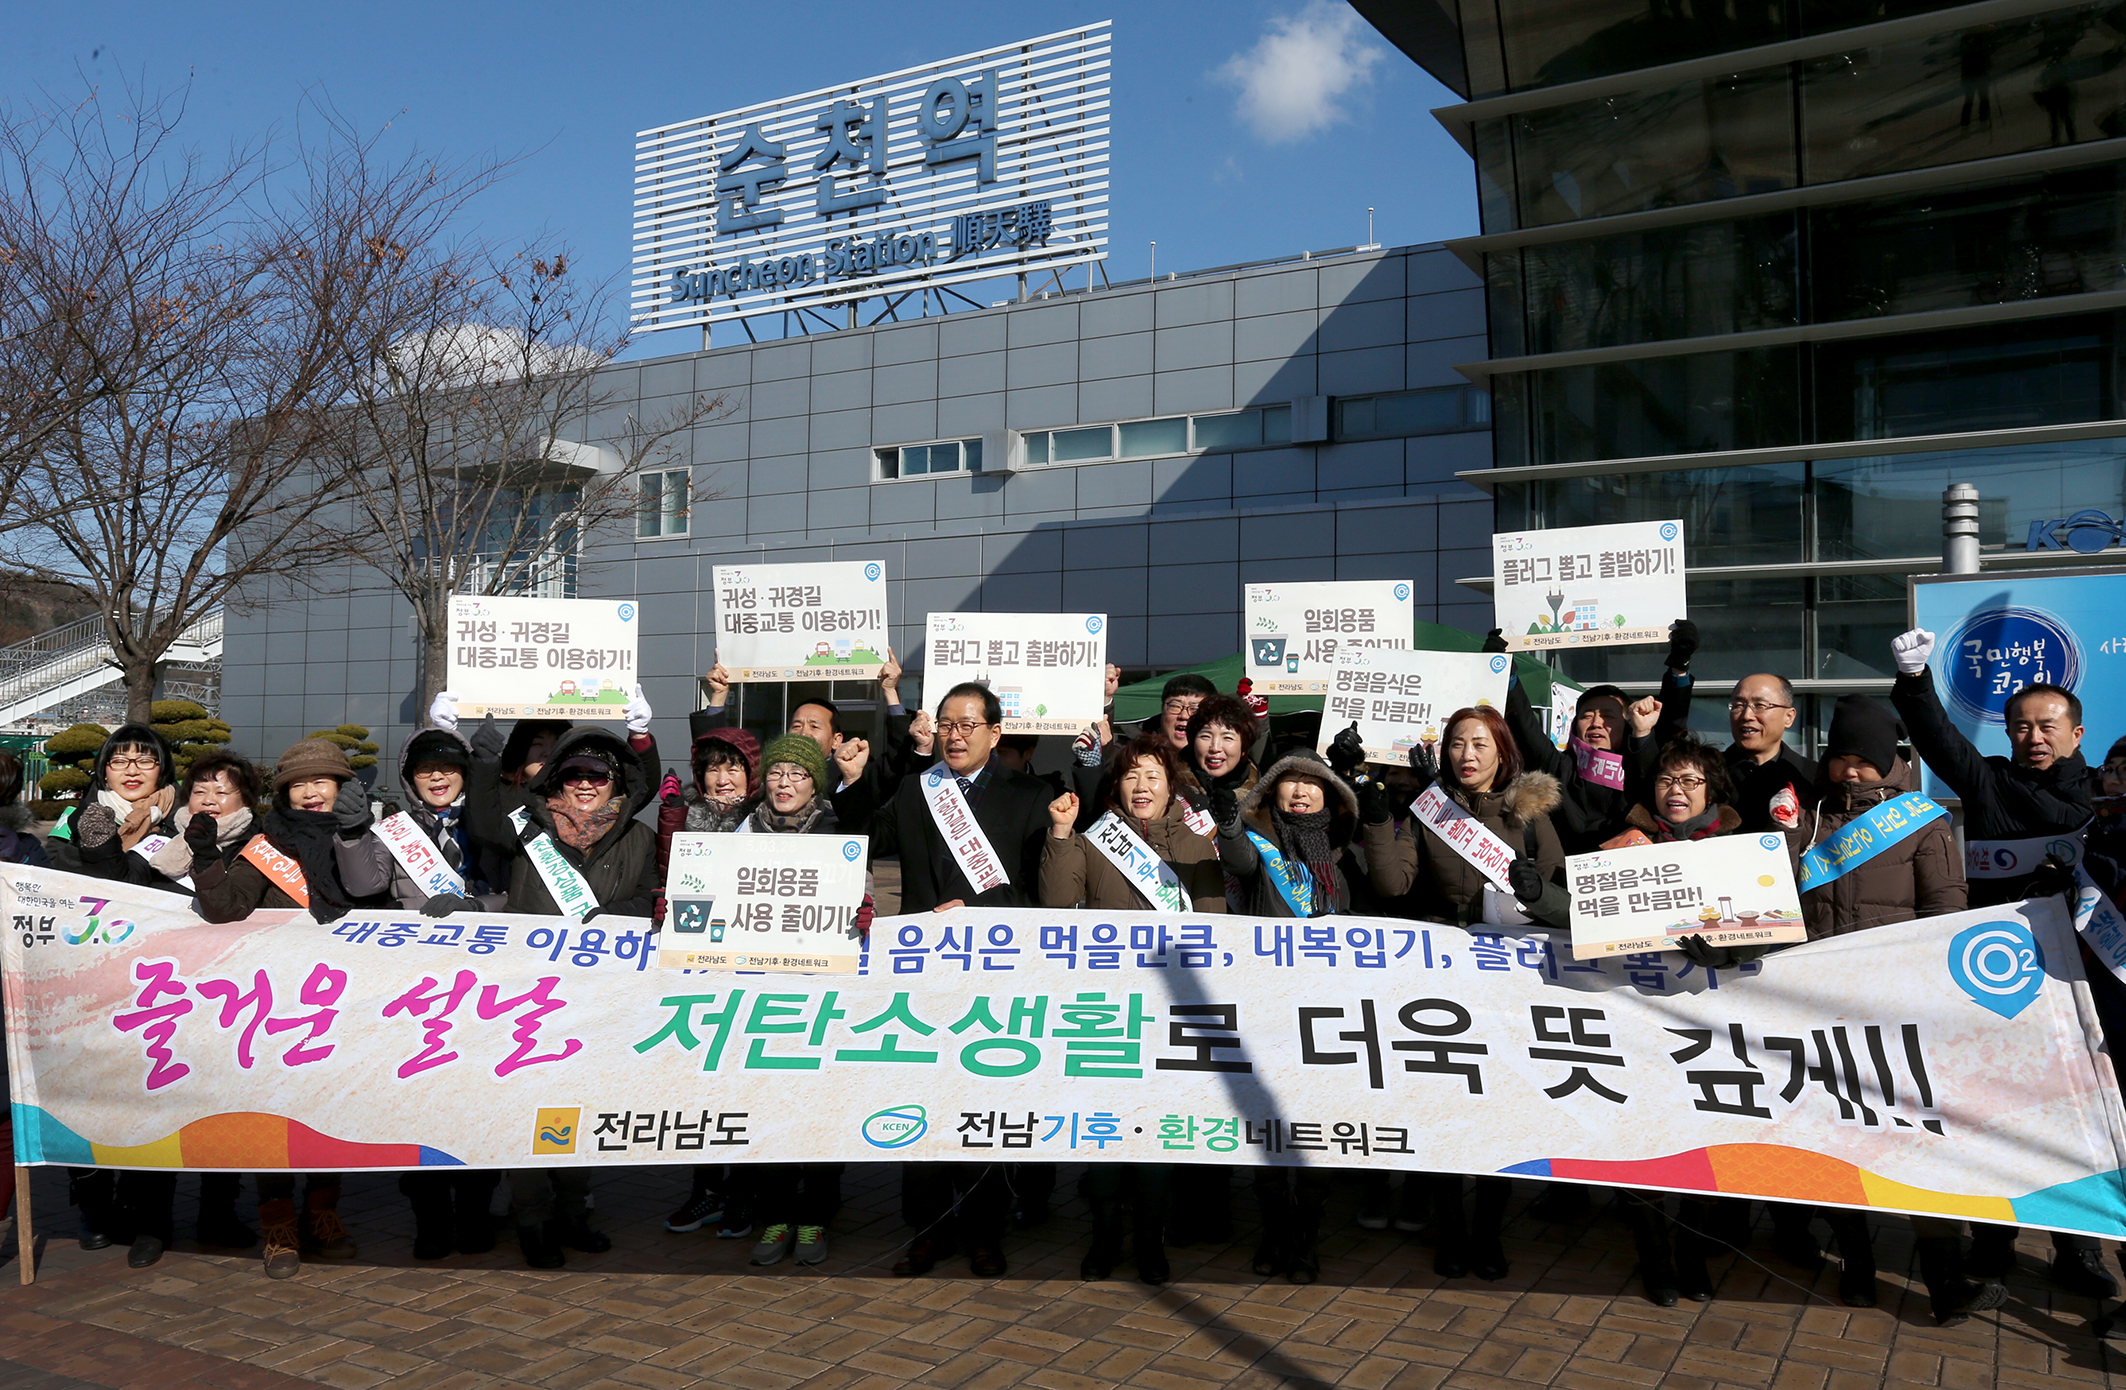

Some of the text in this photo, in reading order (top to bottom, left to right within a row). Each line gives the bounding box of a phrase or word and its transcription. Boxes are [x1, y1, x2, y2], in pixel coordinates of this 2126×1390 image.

[715, 69, 1000, 235] 순천역
[951, 199, 1052, 255] 順天驛
[671, 228, 938, 302] Suncheon Station
[2026, 509, 2126, 554] KO
[1503, 547, 1676, 586] 플러그 뽑고 출발하기!
[724, 609, 881, 634] 대중교통 이용하기!
[1304, 608, 1376, 633] 일회용품
[933, 639, 1098, 667] 플러그 뽑고 출발하기!
[1303, 638, 1338, 663] 사용
[1533, 636, 1562, 646] 전라남도
[2100, 637, 2126, 654] 사
[457, 646, 632, 671] 대중교통 이용하기!
[752, 670, 778, 678] 전라남도
[1963, 638, 2046, 679] 국민행복
[1278, 683, 1304, 691] 전라남도
[1336, 669, 1422, 697] 명절음식은
[486, 706, 516, 716] 전라남도
[1331, 696, 1432, 725] 먹을 만큼만!
[933, 788, 972, 841] 고향길은
[1901, 796, 1934, 818] 내복
[1871, 807, 1908, 839] 입고
[400, 839, 439, 877] 높이고
[1471, 837, 1512, 886] 냉장고
[1813, 827, 1874, 876] 온실가스
[532, 838, 584, 903] 친환경상품
[737, 866, 819, 897] 일회용품
[1575, 862, 1683, 895] 명절음식은
[15, 881, 42, 893] 행복한
[17, 895, 76, 910] 대한민국을 여는
[1577, 886, 1705, 918] 먹을 만큼만!
[12, 895, 135, 949] 정부 3.0
[731, 902, 852, 935] 사용 줄이기!
[332, 920, 511, 955] 대중교통
[525, 927, 657, 972] 이용하
[888, 923, 1021, 974] 음식은
[1039, 923, 1234, 970] 먹을만큼,
[1253, 924, 1453, 971] 내복입기,
[697, 955, 728, 965] 전라남도
[1617, 939, 1654, 951] 전라남도
[113, 961, 349, 1091] 즐거운
[382, 968, 584, 1081] 설날
[632, 988, 1254, 1079] 저탄소생활로
[1297, 997, 1490, 1095] 더욱
[1528, 1004, 1629, 1105] 뜻
[593, 1109, 751, 1153] 전라남도
[882, 1122, 910, 1132] KCEN
